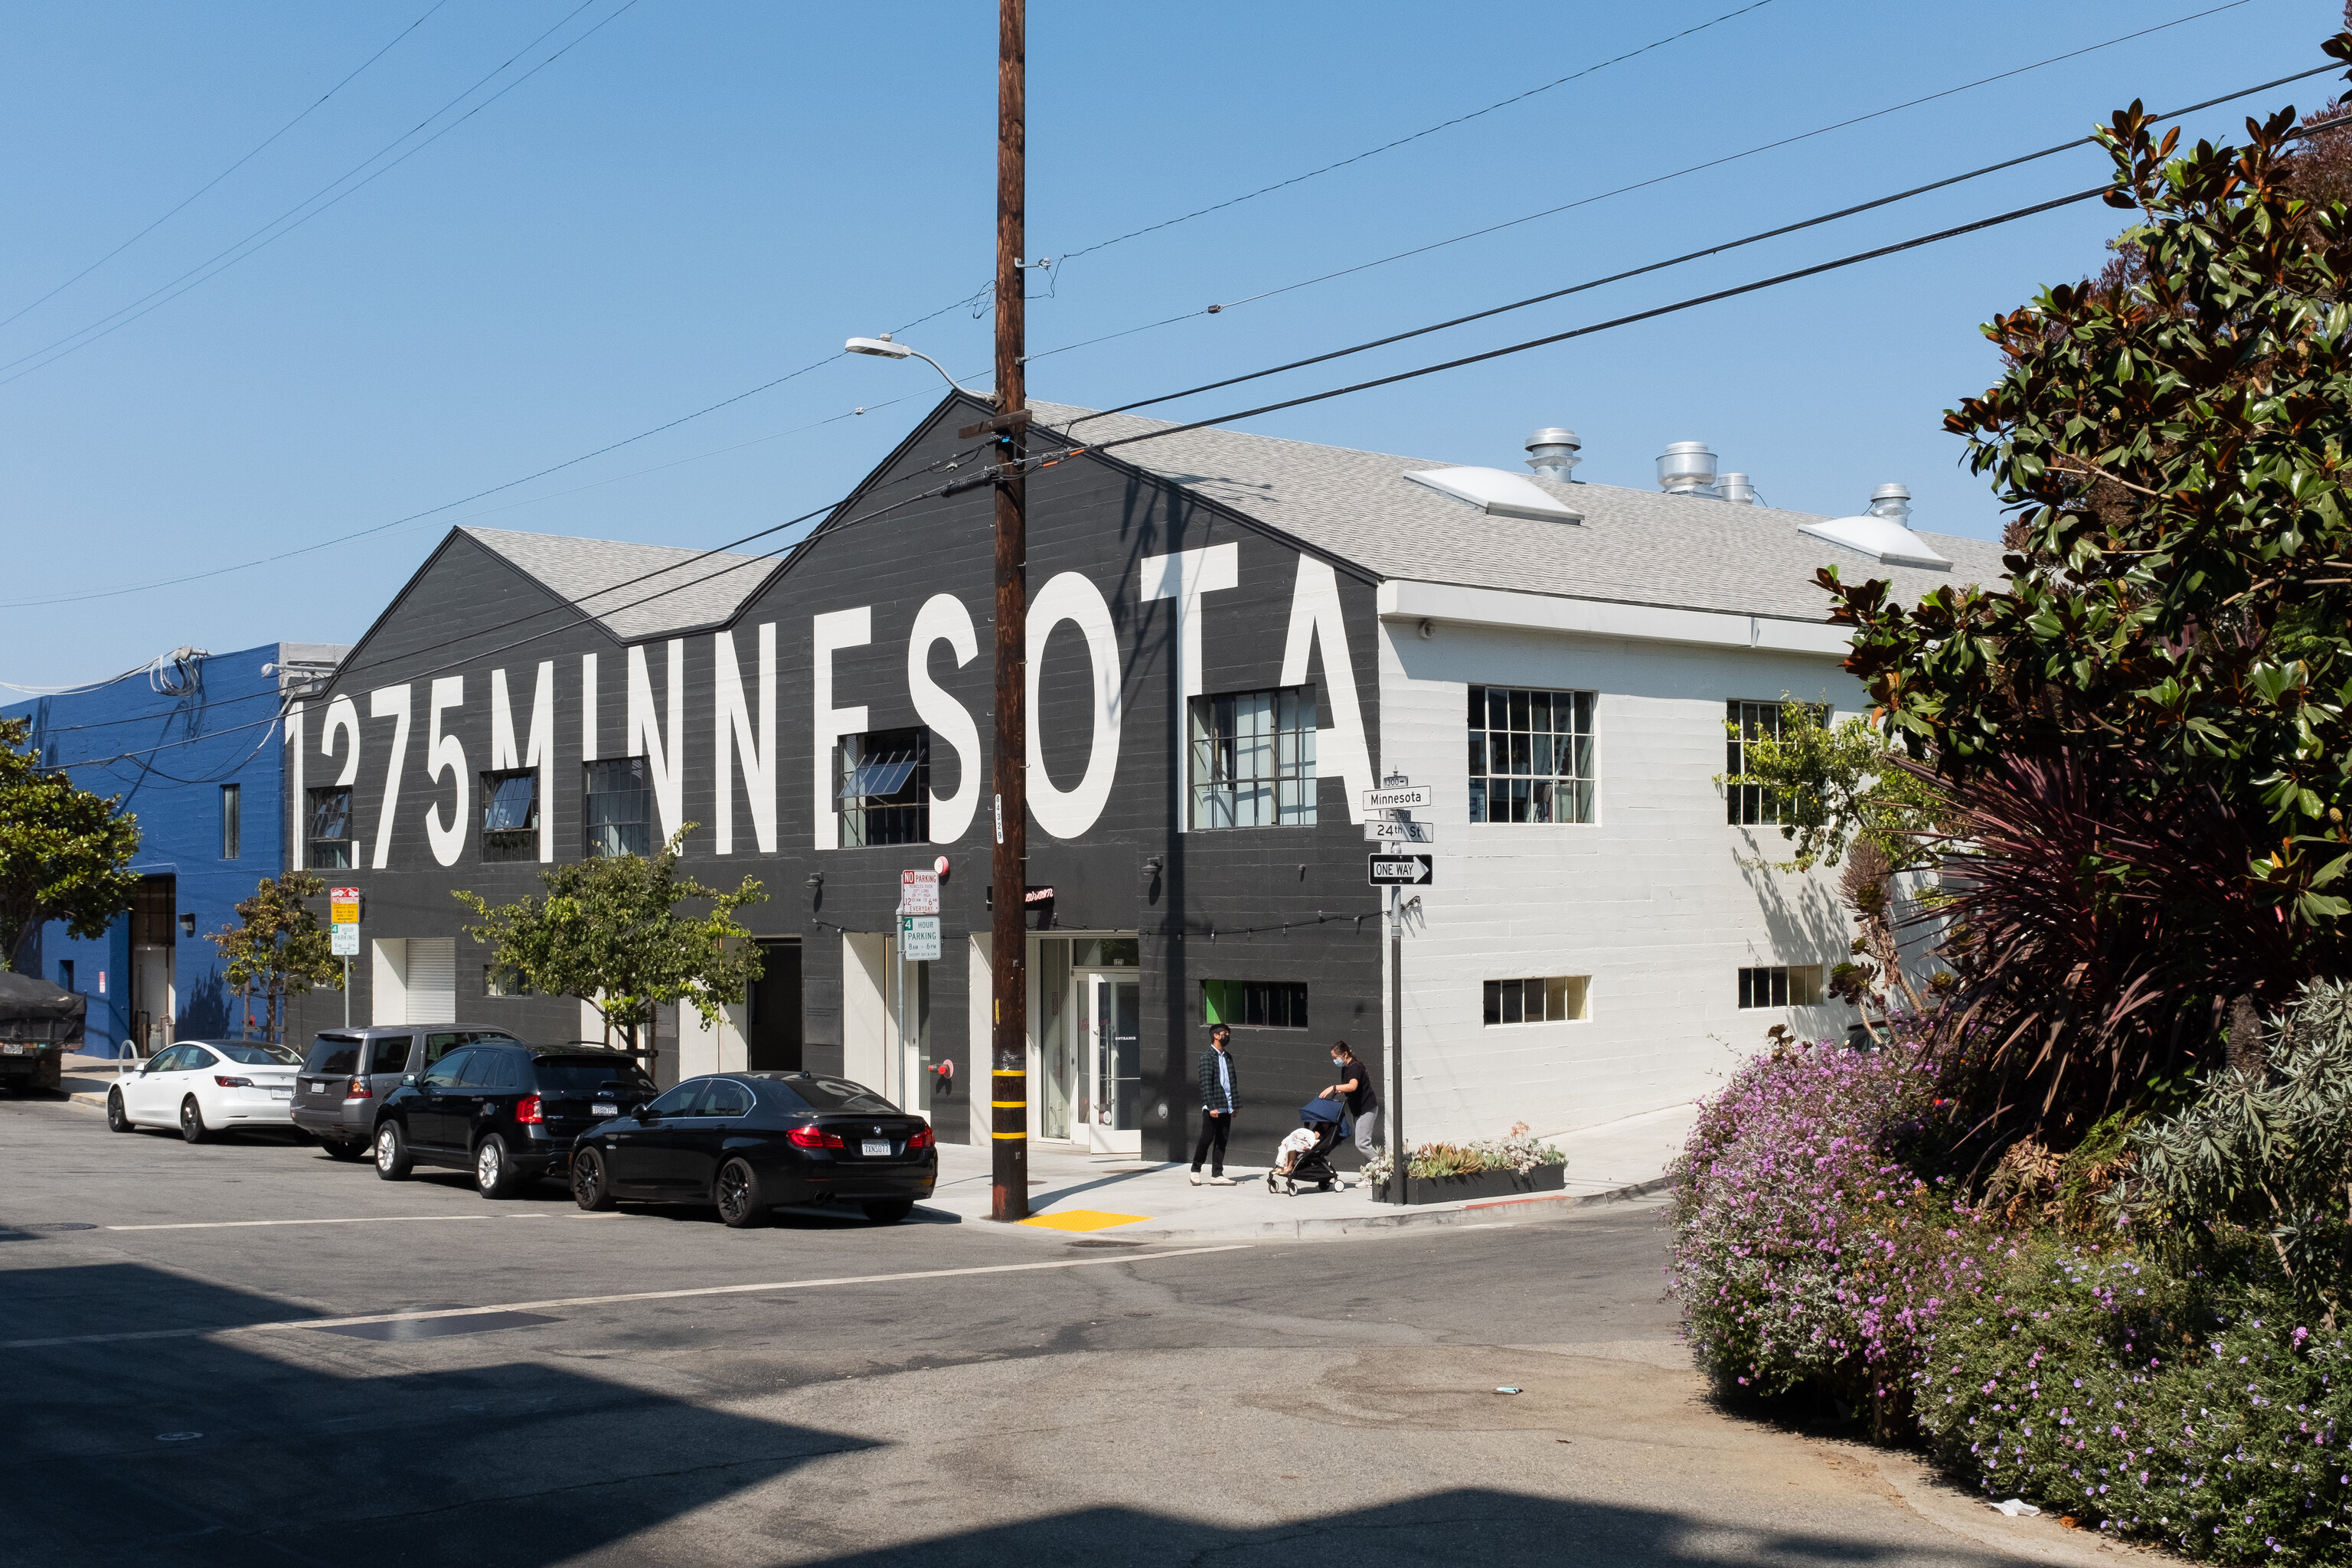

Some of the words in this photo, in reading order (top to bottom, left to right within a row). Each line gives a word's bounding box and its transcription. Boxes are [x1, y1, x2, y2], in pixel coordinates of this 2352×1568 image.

[285, 675, 469, 871] 1275
[491, 541, 1381, 864] MINNESOTA
[1385, 778, 1399, 786] 1300
[1370, 791, 1421, 805] Minnesota
[1377, 824, 1403, 836] 24th
[1410, 827, 1421, 838] St
[1376, 864, 1393, 876] ONE
[1396, 864, 1414, 876] WAY
[904, 872, 914, 883] NO
[905, 920, 911, 929] 4
[908, 932, 936, 940] PARKING
